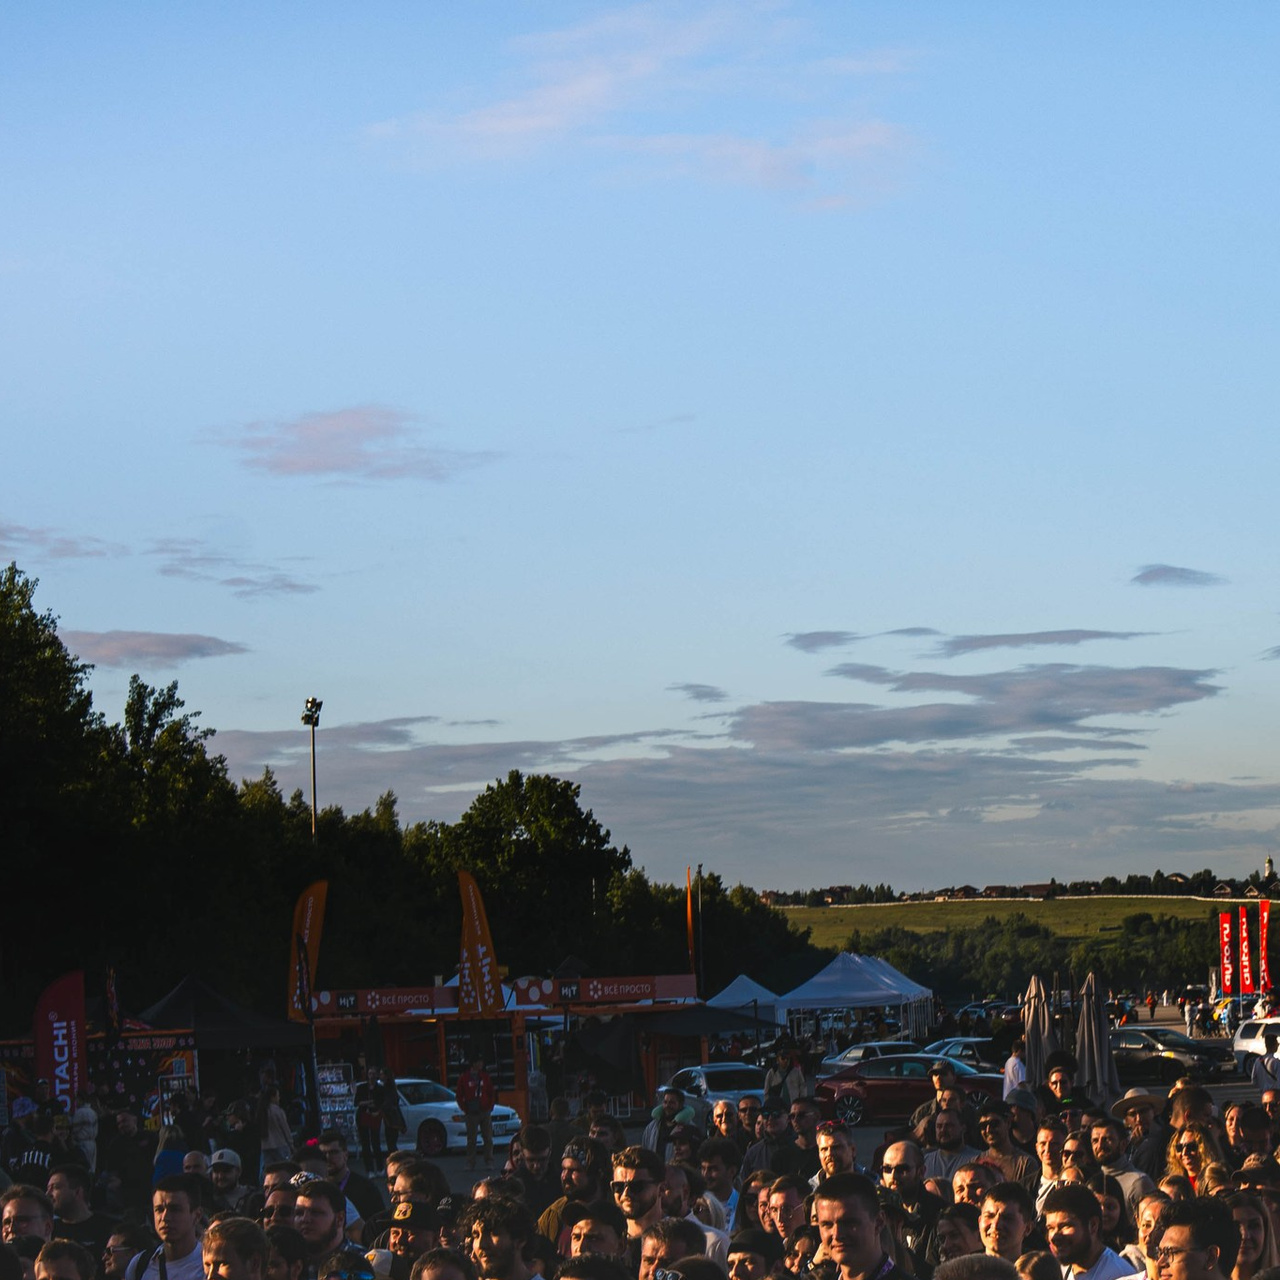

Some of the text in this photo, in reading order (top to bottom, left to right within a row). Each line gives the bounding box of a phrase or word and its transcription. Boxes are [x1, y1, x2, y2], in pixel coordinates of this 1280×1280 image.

[1222, 923, 1233, 987] auto.ru
[619, 983, 651, 995] ПРОСТО
[397, 994, 430, 1004] ПРОСТО
